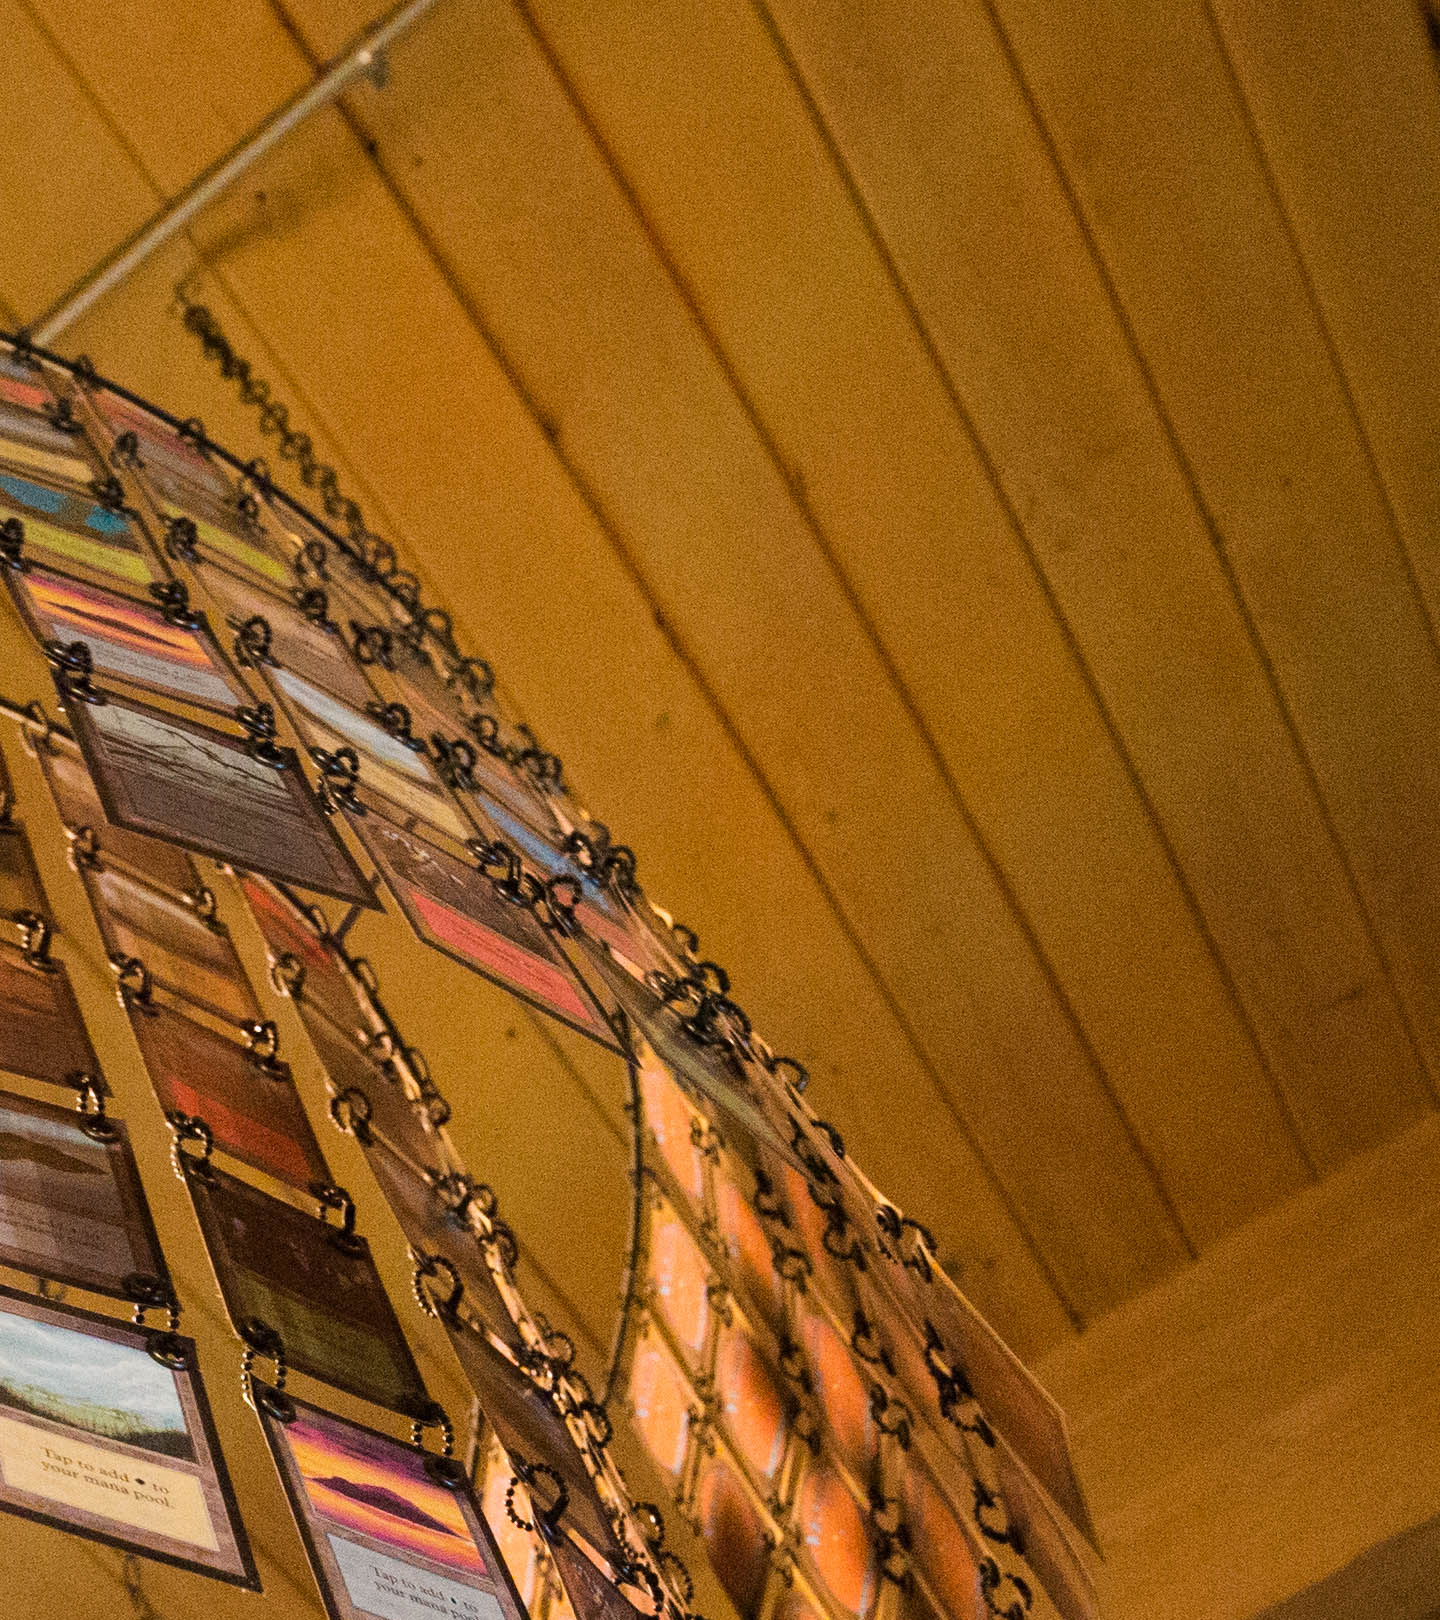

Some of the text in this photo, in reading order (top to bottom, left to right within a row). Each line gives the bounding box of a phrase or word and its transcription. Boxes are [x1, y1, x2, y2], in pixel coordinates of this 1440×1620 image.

[41, 1447, 170, 1494] Tap to add to
[41, 1460, 78, 1479] your
[83, 1475, 130, 1495] mana
[369, 1565, 479, 1614] Tap to add to
[374, 1580, 405, 1600] your
[409, 1594, 448, 1615] mana
